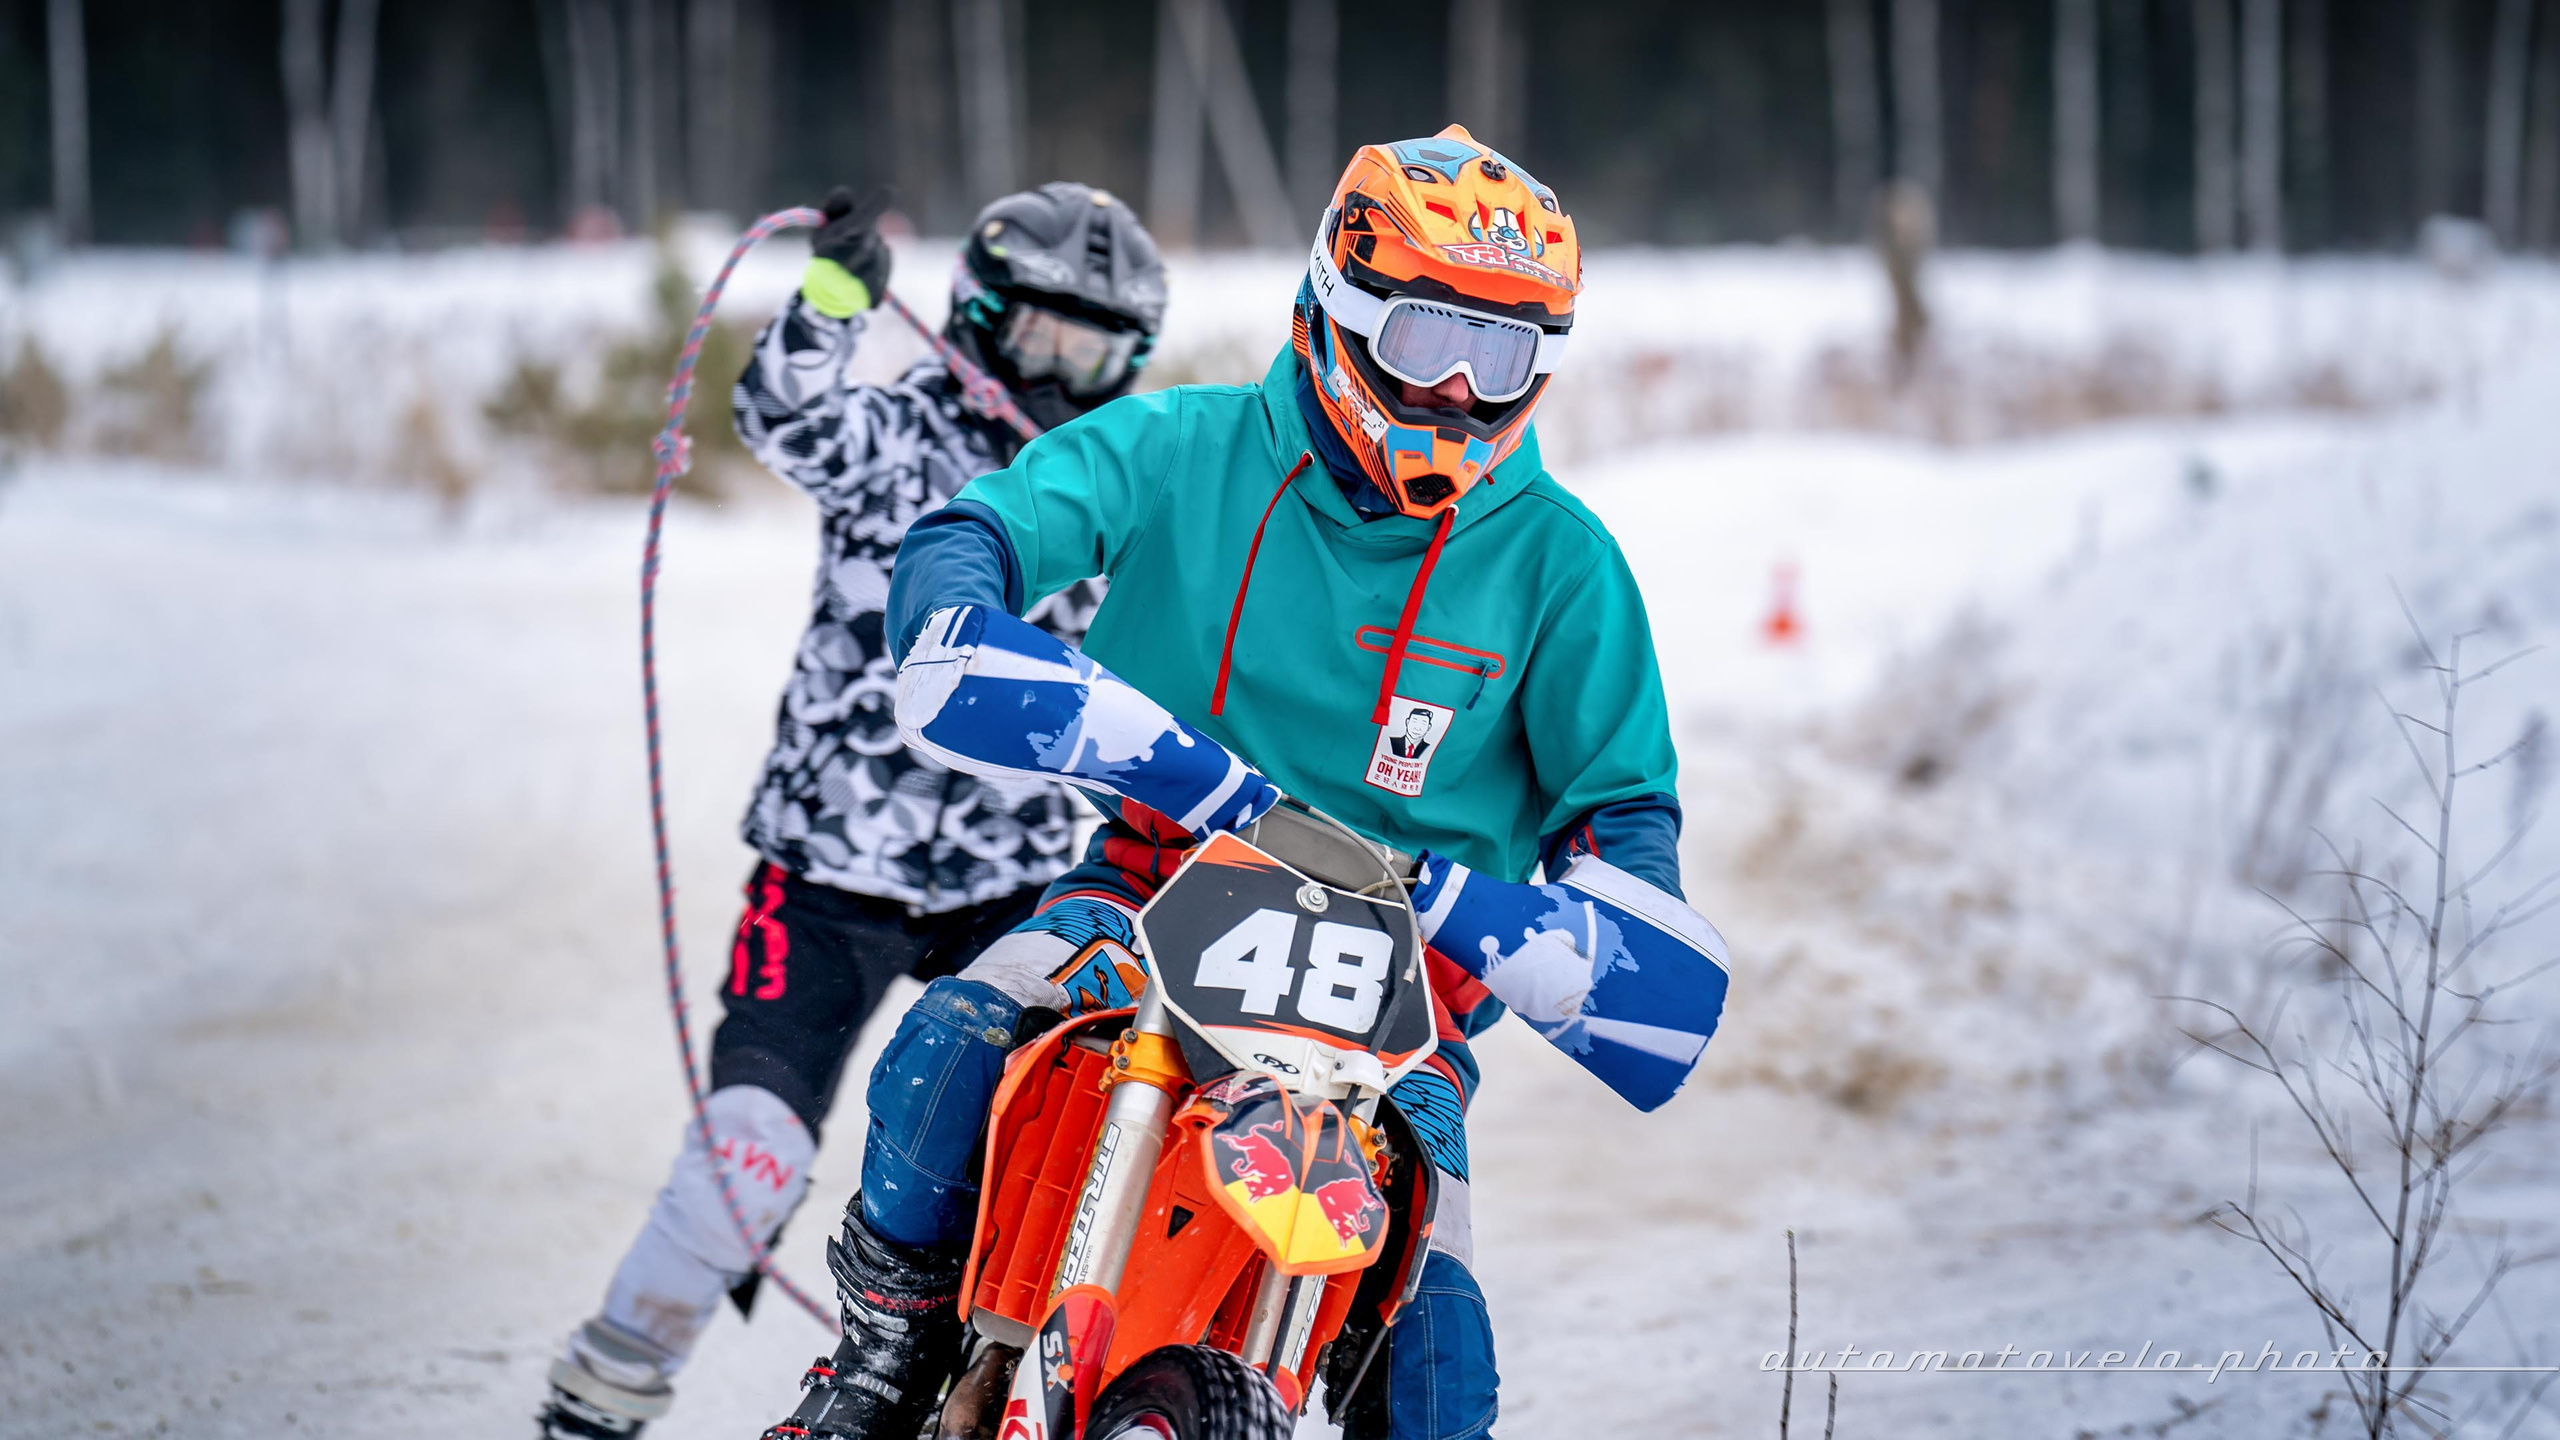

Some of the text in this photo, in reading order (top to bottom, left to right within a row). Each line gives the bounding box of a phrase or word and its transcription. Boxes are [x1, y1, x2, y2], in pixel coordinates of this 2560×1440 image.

[1377, 761, 1394, 777] OH
[1193, 907, 1394, 1034] 48
[1042, 1330, 1069, 1393] SX
